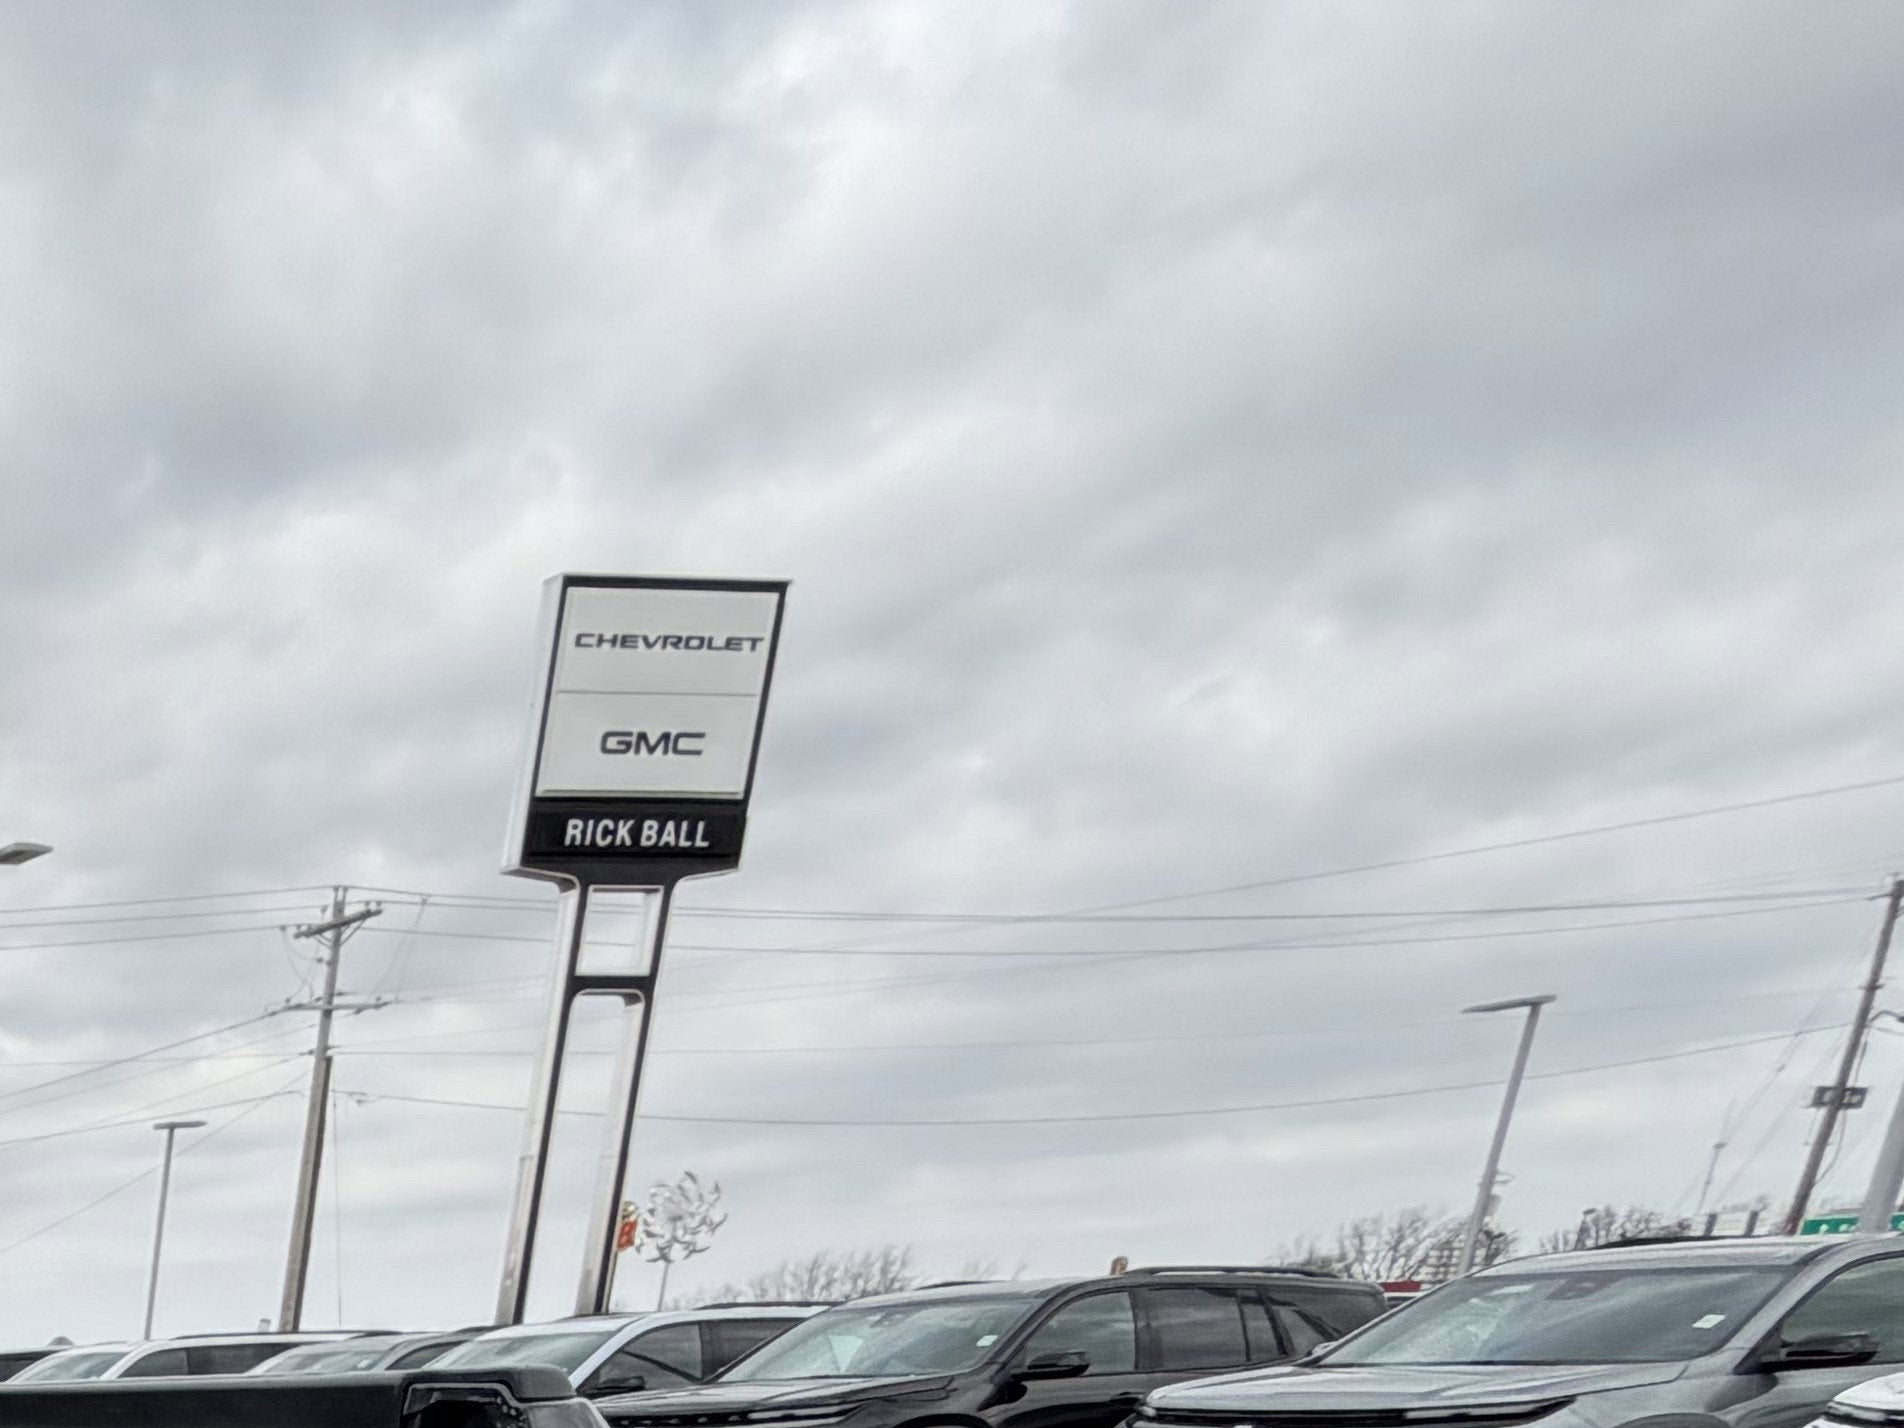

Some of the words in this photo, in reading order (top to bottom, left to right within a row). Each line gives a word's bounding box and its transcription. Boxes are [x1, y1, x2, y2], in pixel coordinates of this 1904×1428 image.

[574, 632, 765, 652] CHEVROLET
[600, 730, 706, 756] GMC
[564, 818, 633, 847] RICK
[641, 819, 710, 848] BALL
